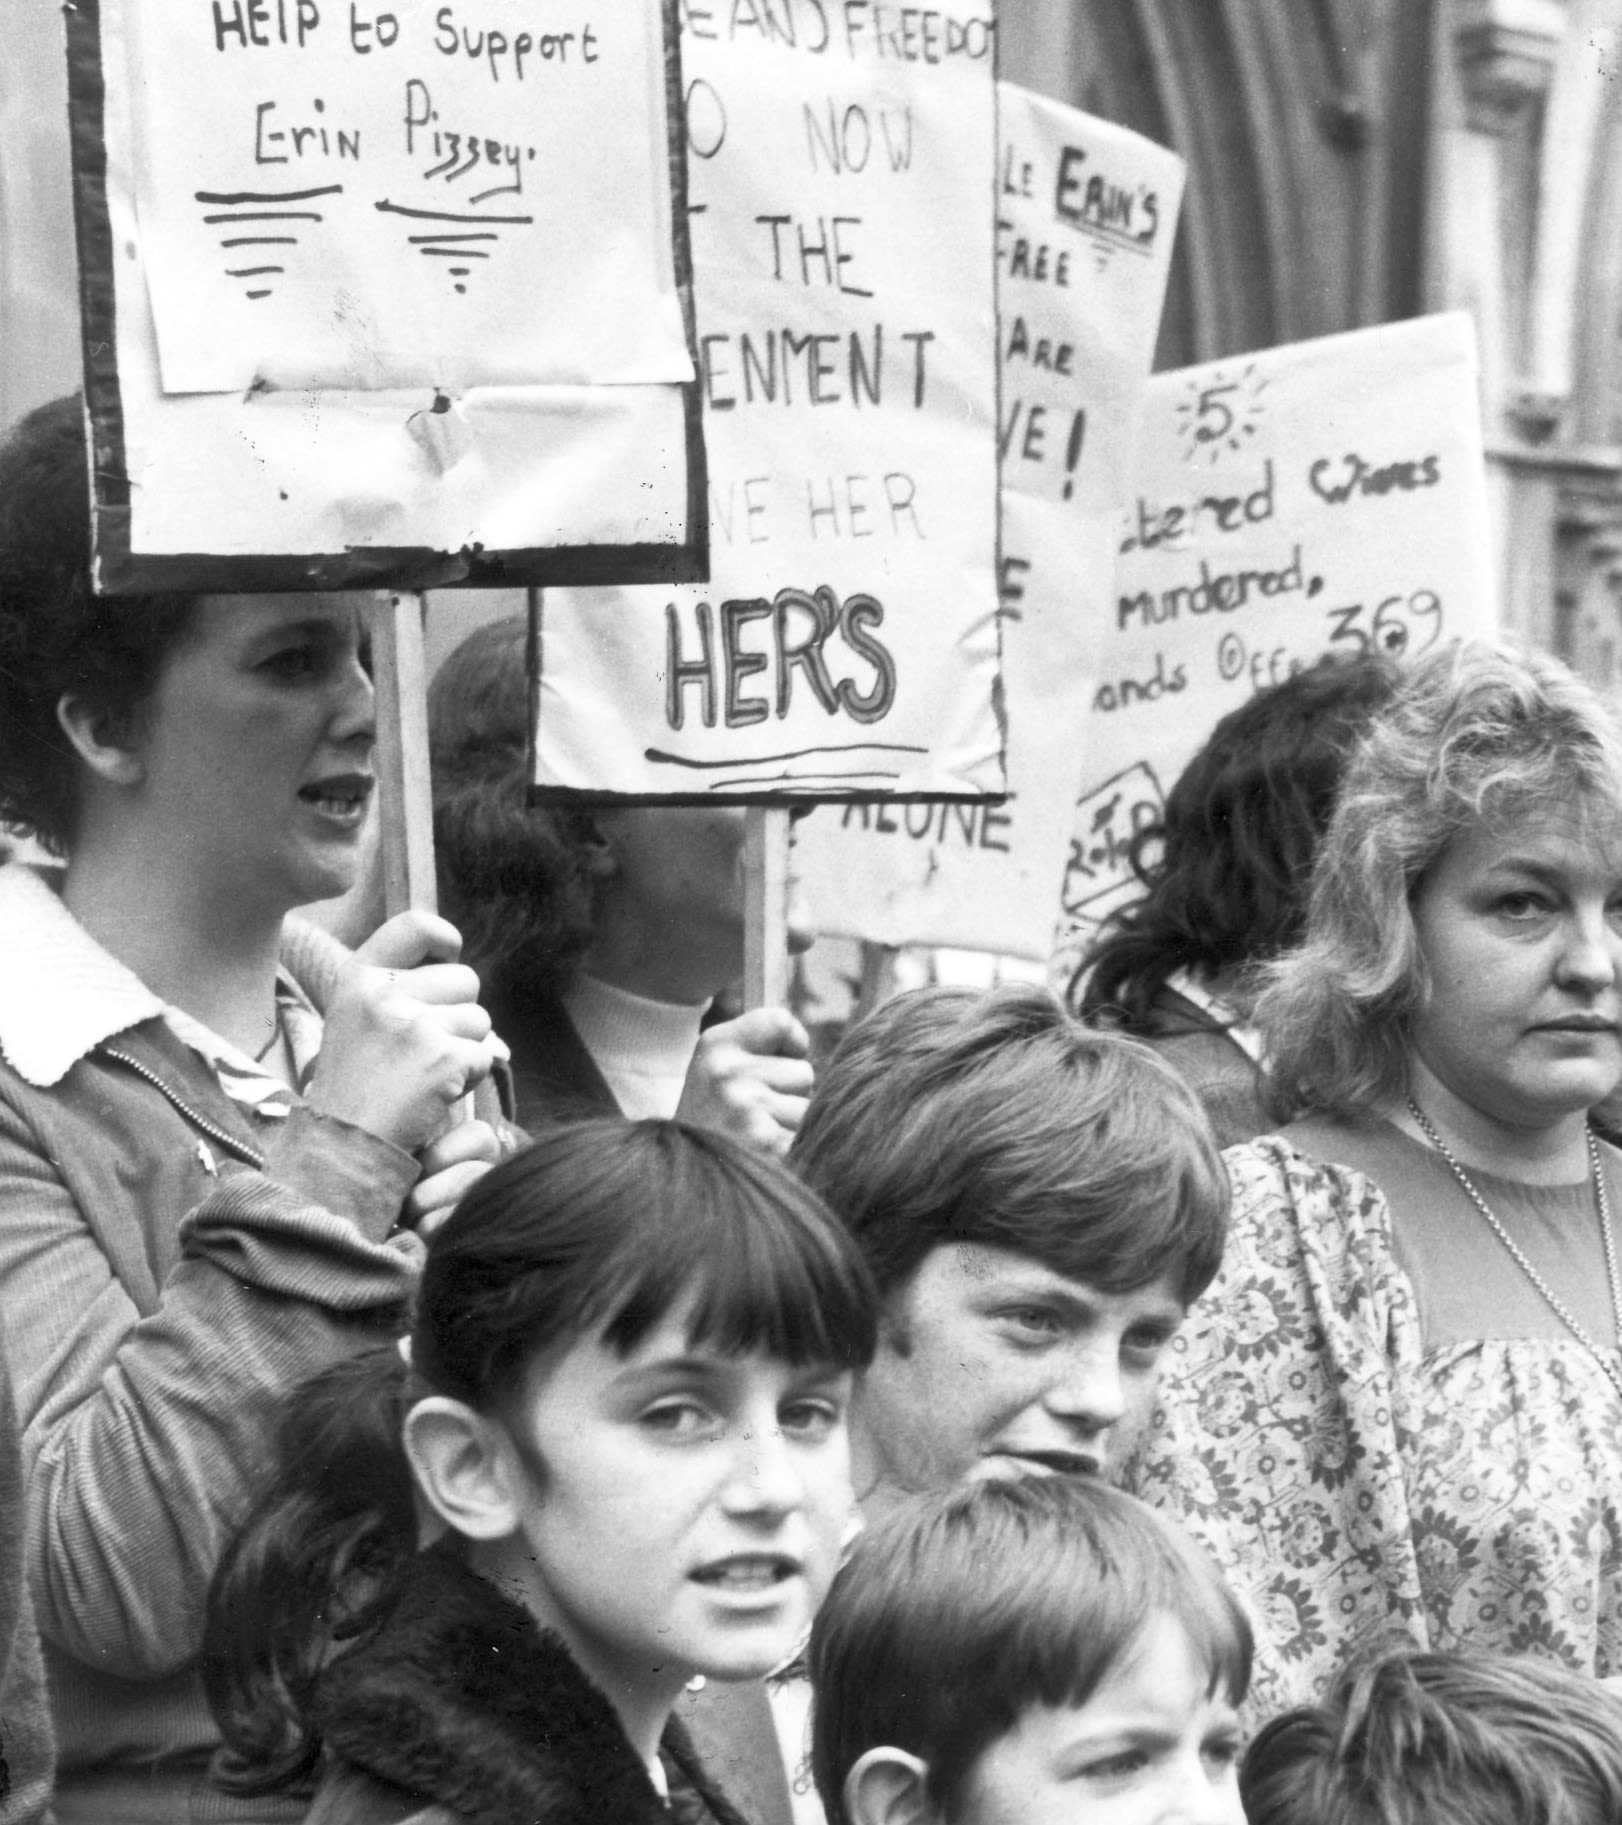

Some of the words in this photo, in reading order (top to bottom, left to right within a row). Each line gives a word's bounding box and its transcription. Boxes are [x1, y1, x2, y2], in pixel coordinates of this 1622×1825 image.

[350, 0, 399, 54] to
[434, 8, 599, 80] Support
[255, 98, 360, 164] Erin
[803, 97, 913, 175] NOW
[754, 214, 874, 297] THE
[807, 472, 927, 540] HER
[1119, 459, 1273, 554] tered
[665, 585, 896, 731] HER'S
